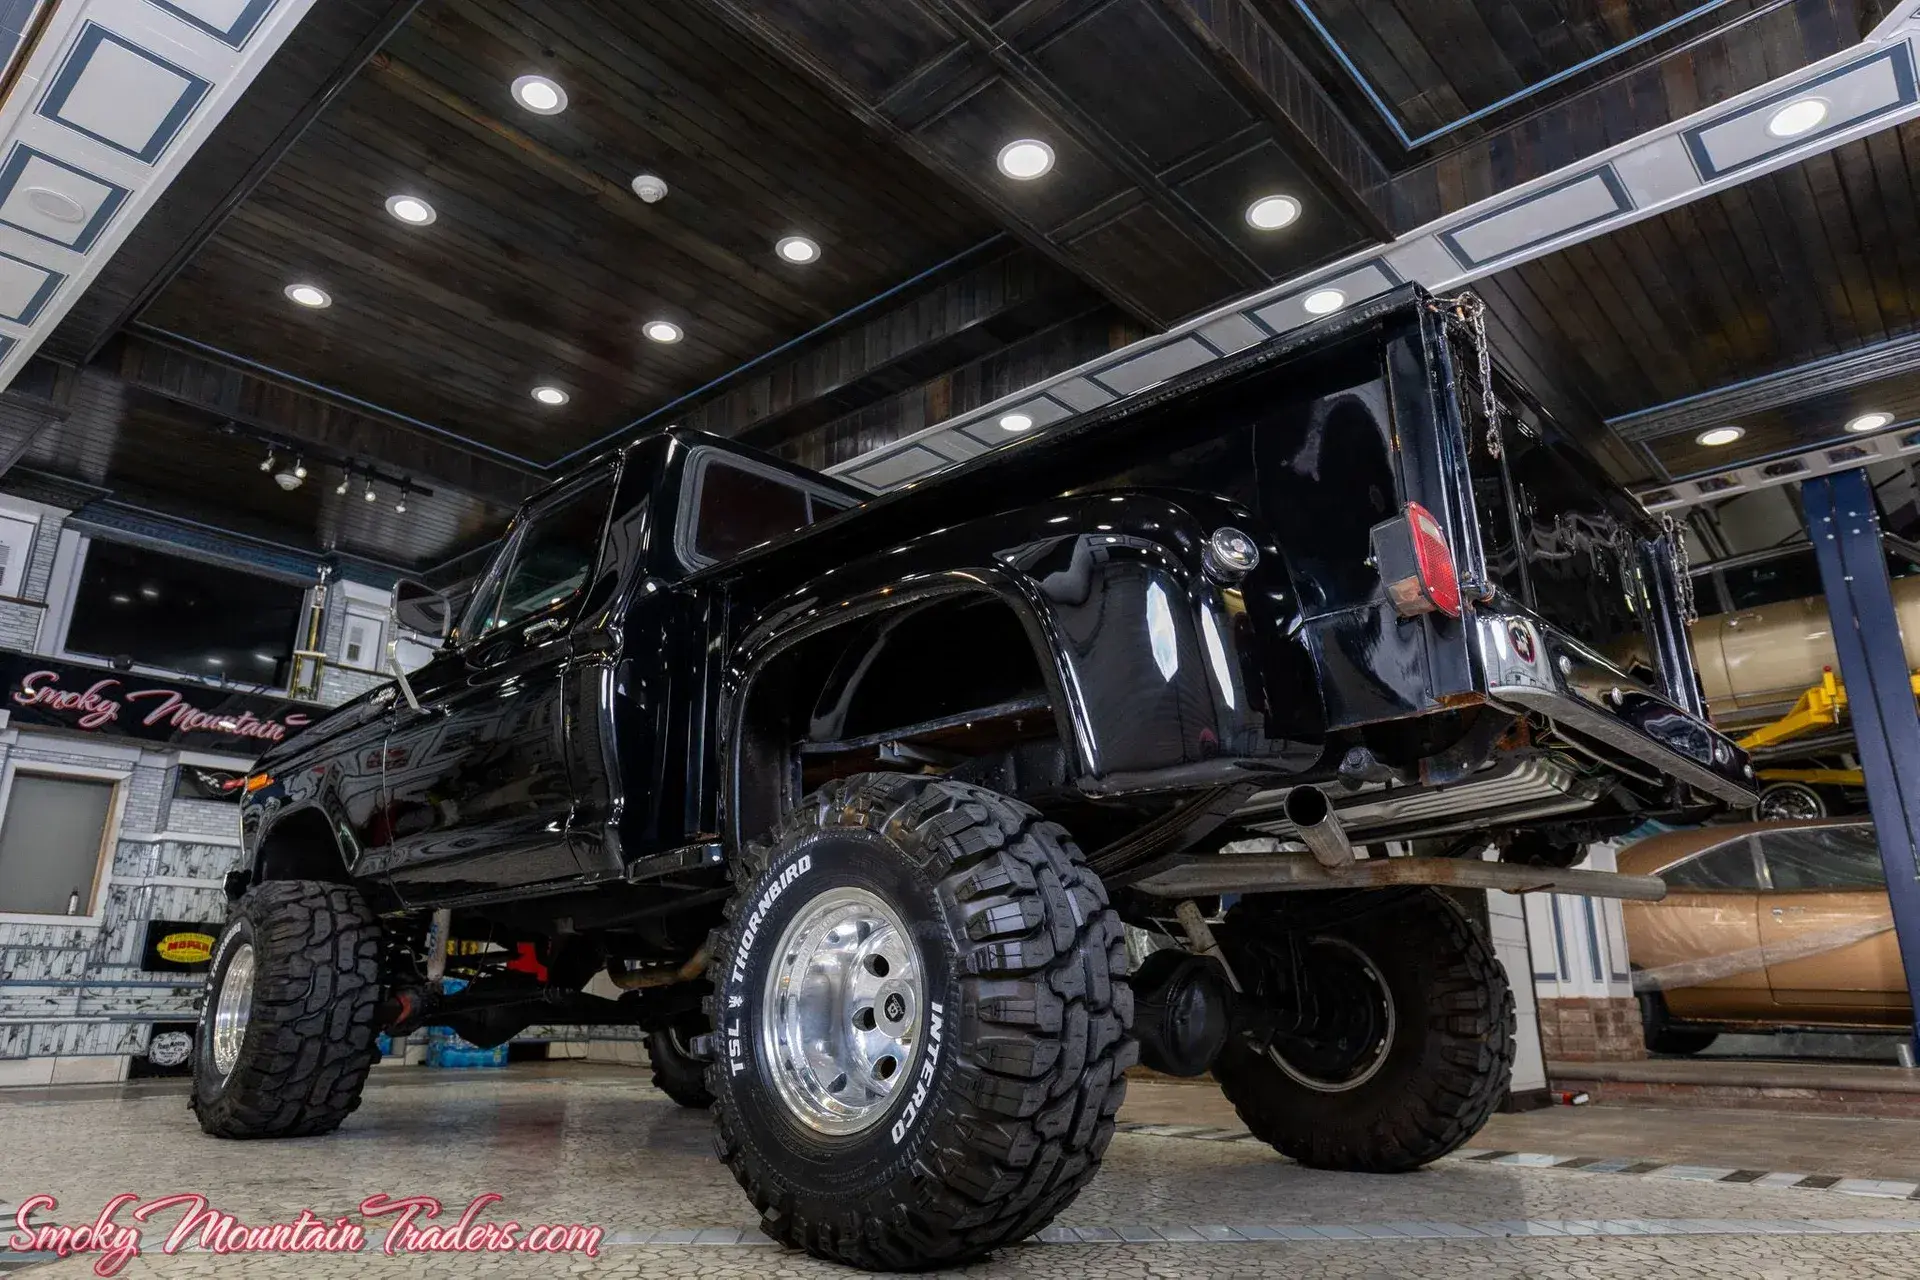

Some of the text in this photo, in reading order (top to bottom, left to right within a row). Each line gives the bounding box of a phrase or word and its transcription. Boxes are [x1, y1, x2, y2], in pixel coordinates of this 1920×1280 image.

[12, 670, 286, 741] Smoky Mountain
[728, 854, 811, 1076] TSL THORNBIRD
[891, 1001, 944, 1144] INTERCO
